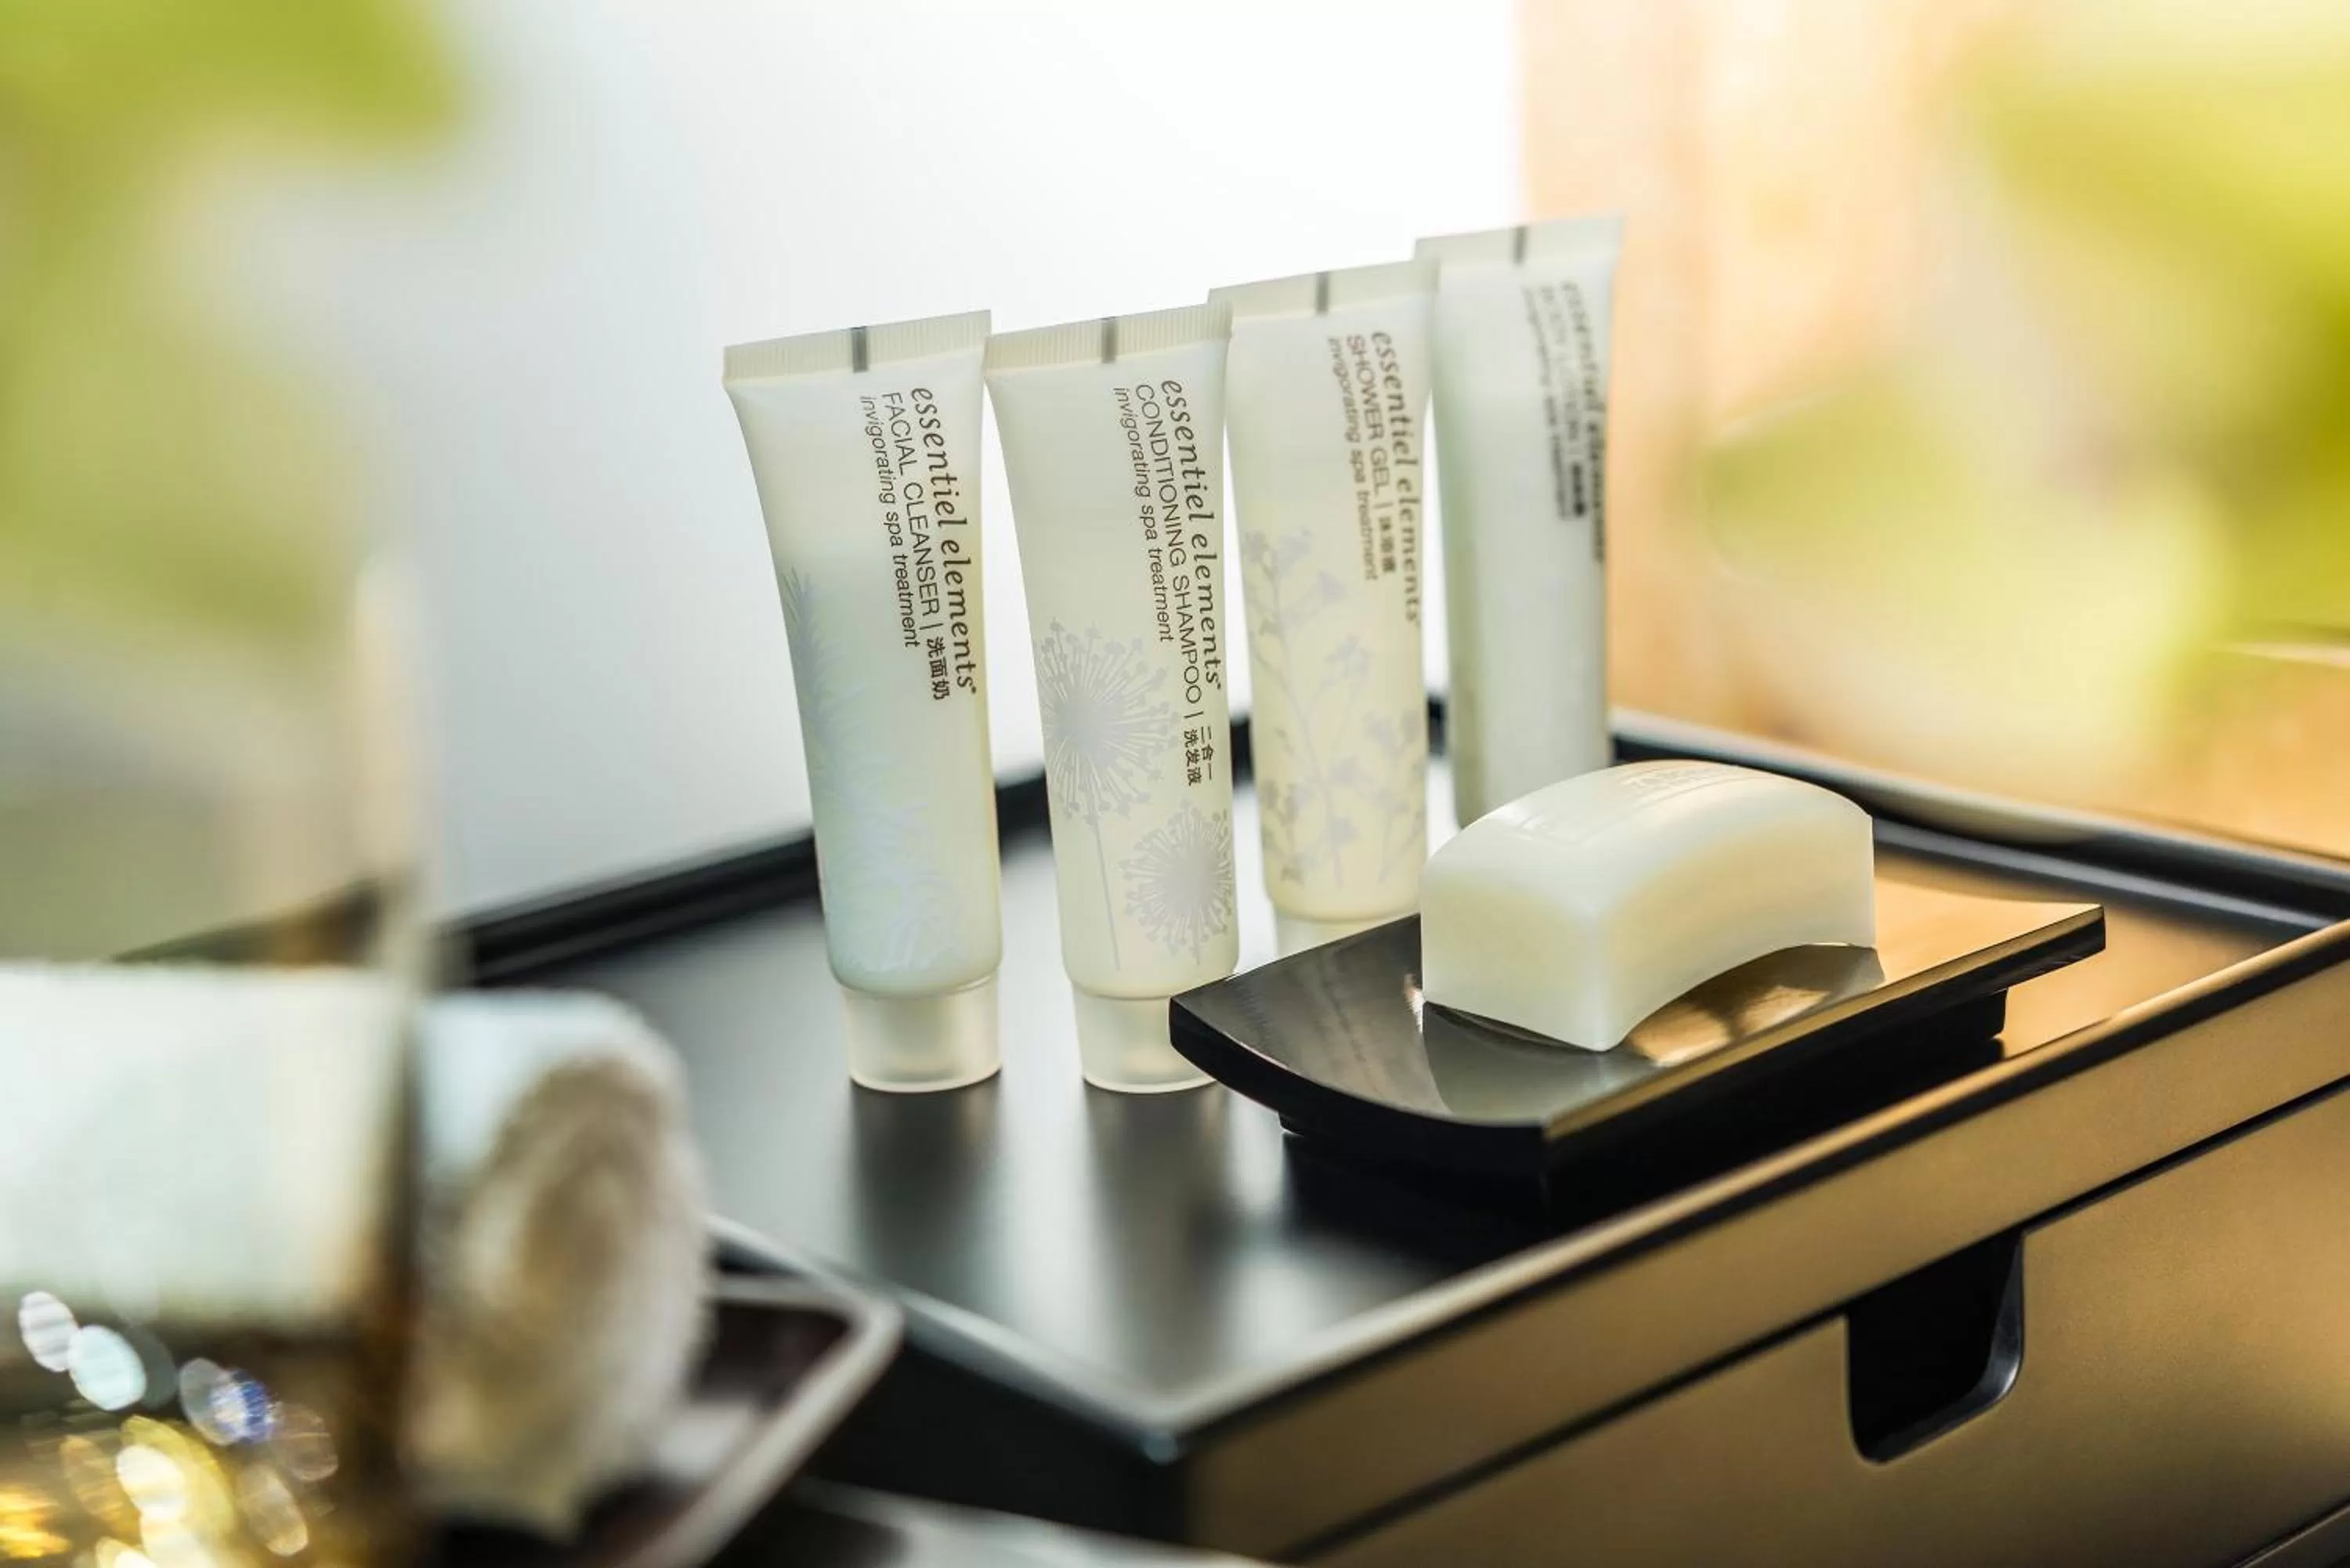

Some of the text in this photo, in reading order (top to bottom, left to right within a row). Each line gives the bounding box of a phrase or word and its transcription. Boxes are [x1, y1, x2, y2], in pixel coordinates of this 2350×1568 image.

[910, 387, 968, 529] essentiel
[1161, 379, 1215, 522] essentiel
[1328, 336, 1379, 581] invigorating spa treatment
[1346, 334, 1390, 497] SHOWER GEL
[1371, 331, 1418, 466] essentiel
[859, 395, 921, 648] invigorating spa treatment
[880, 391, 940, 616] FACIAL CLEANSER
[1112, 386, 1175, 643] invigorating spa treatment
[1135, 384, 1203, 705] CONDITIONING SHAMPOO
[926, 636, 951, 701] 洗面奶
[1183, 728, 1202, 787] 洗发液
[1199, 724, 1214, 782] 二合一
